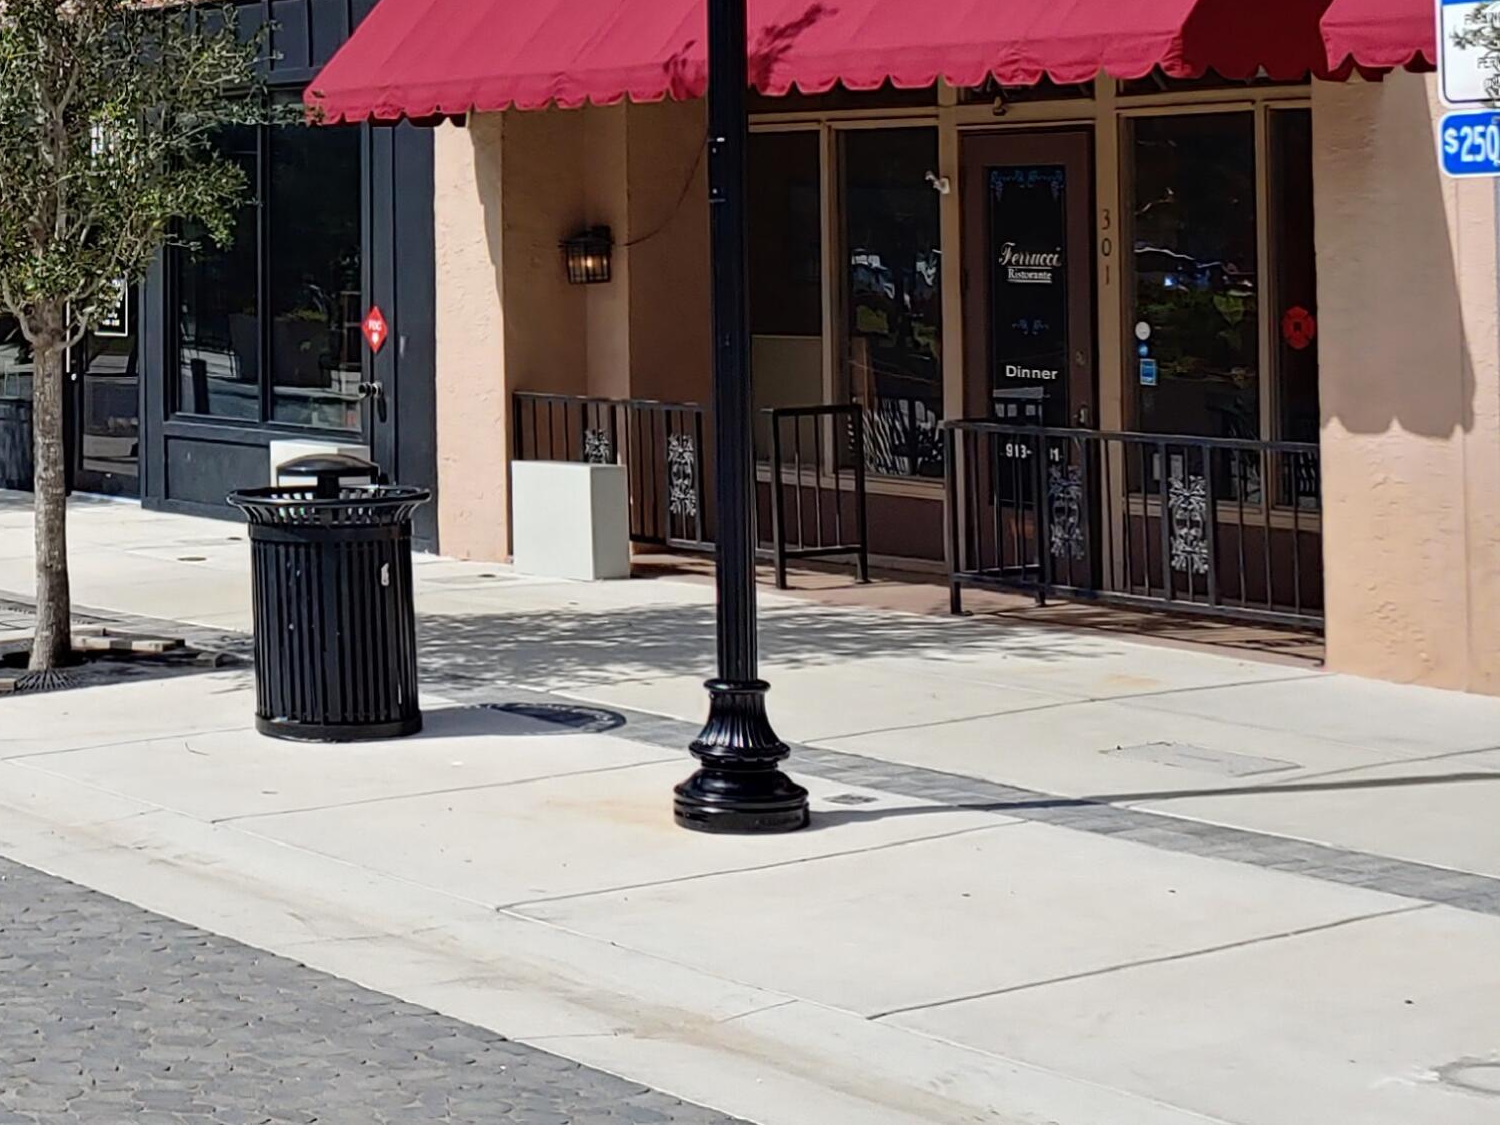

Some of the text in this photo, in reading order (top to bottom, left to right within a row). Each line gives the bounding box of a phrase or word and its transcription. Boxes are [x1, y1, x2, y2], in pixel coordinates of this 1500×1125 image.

[1444, 125, 1499, 162] $250
[999, 241, 1061, 266] Ferrucci
[1005, 364, 1058, 380] Dinner
